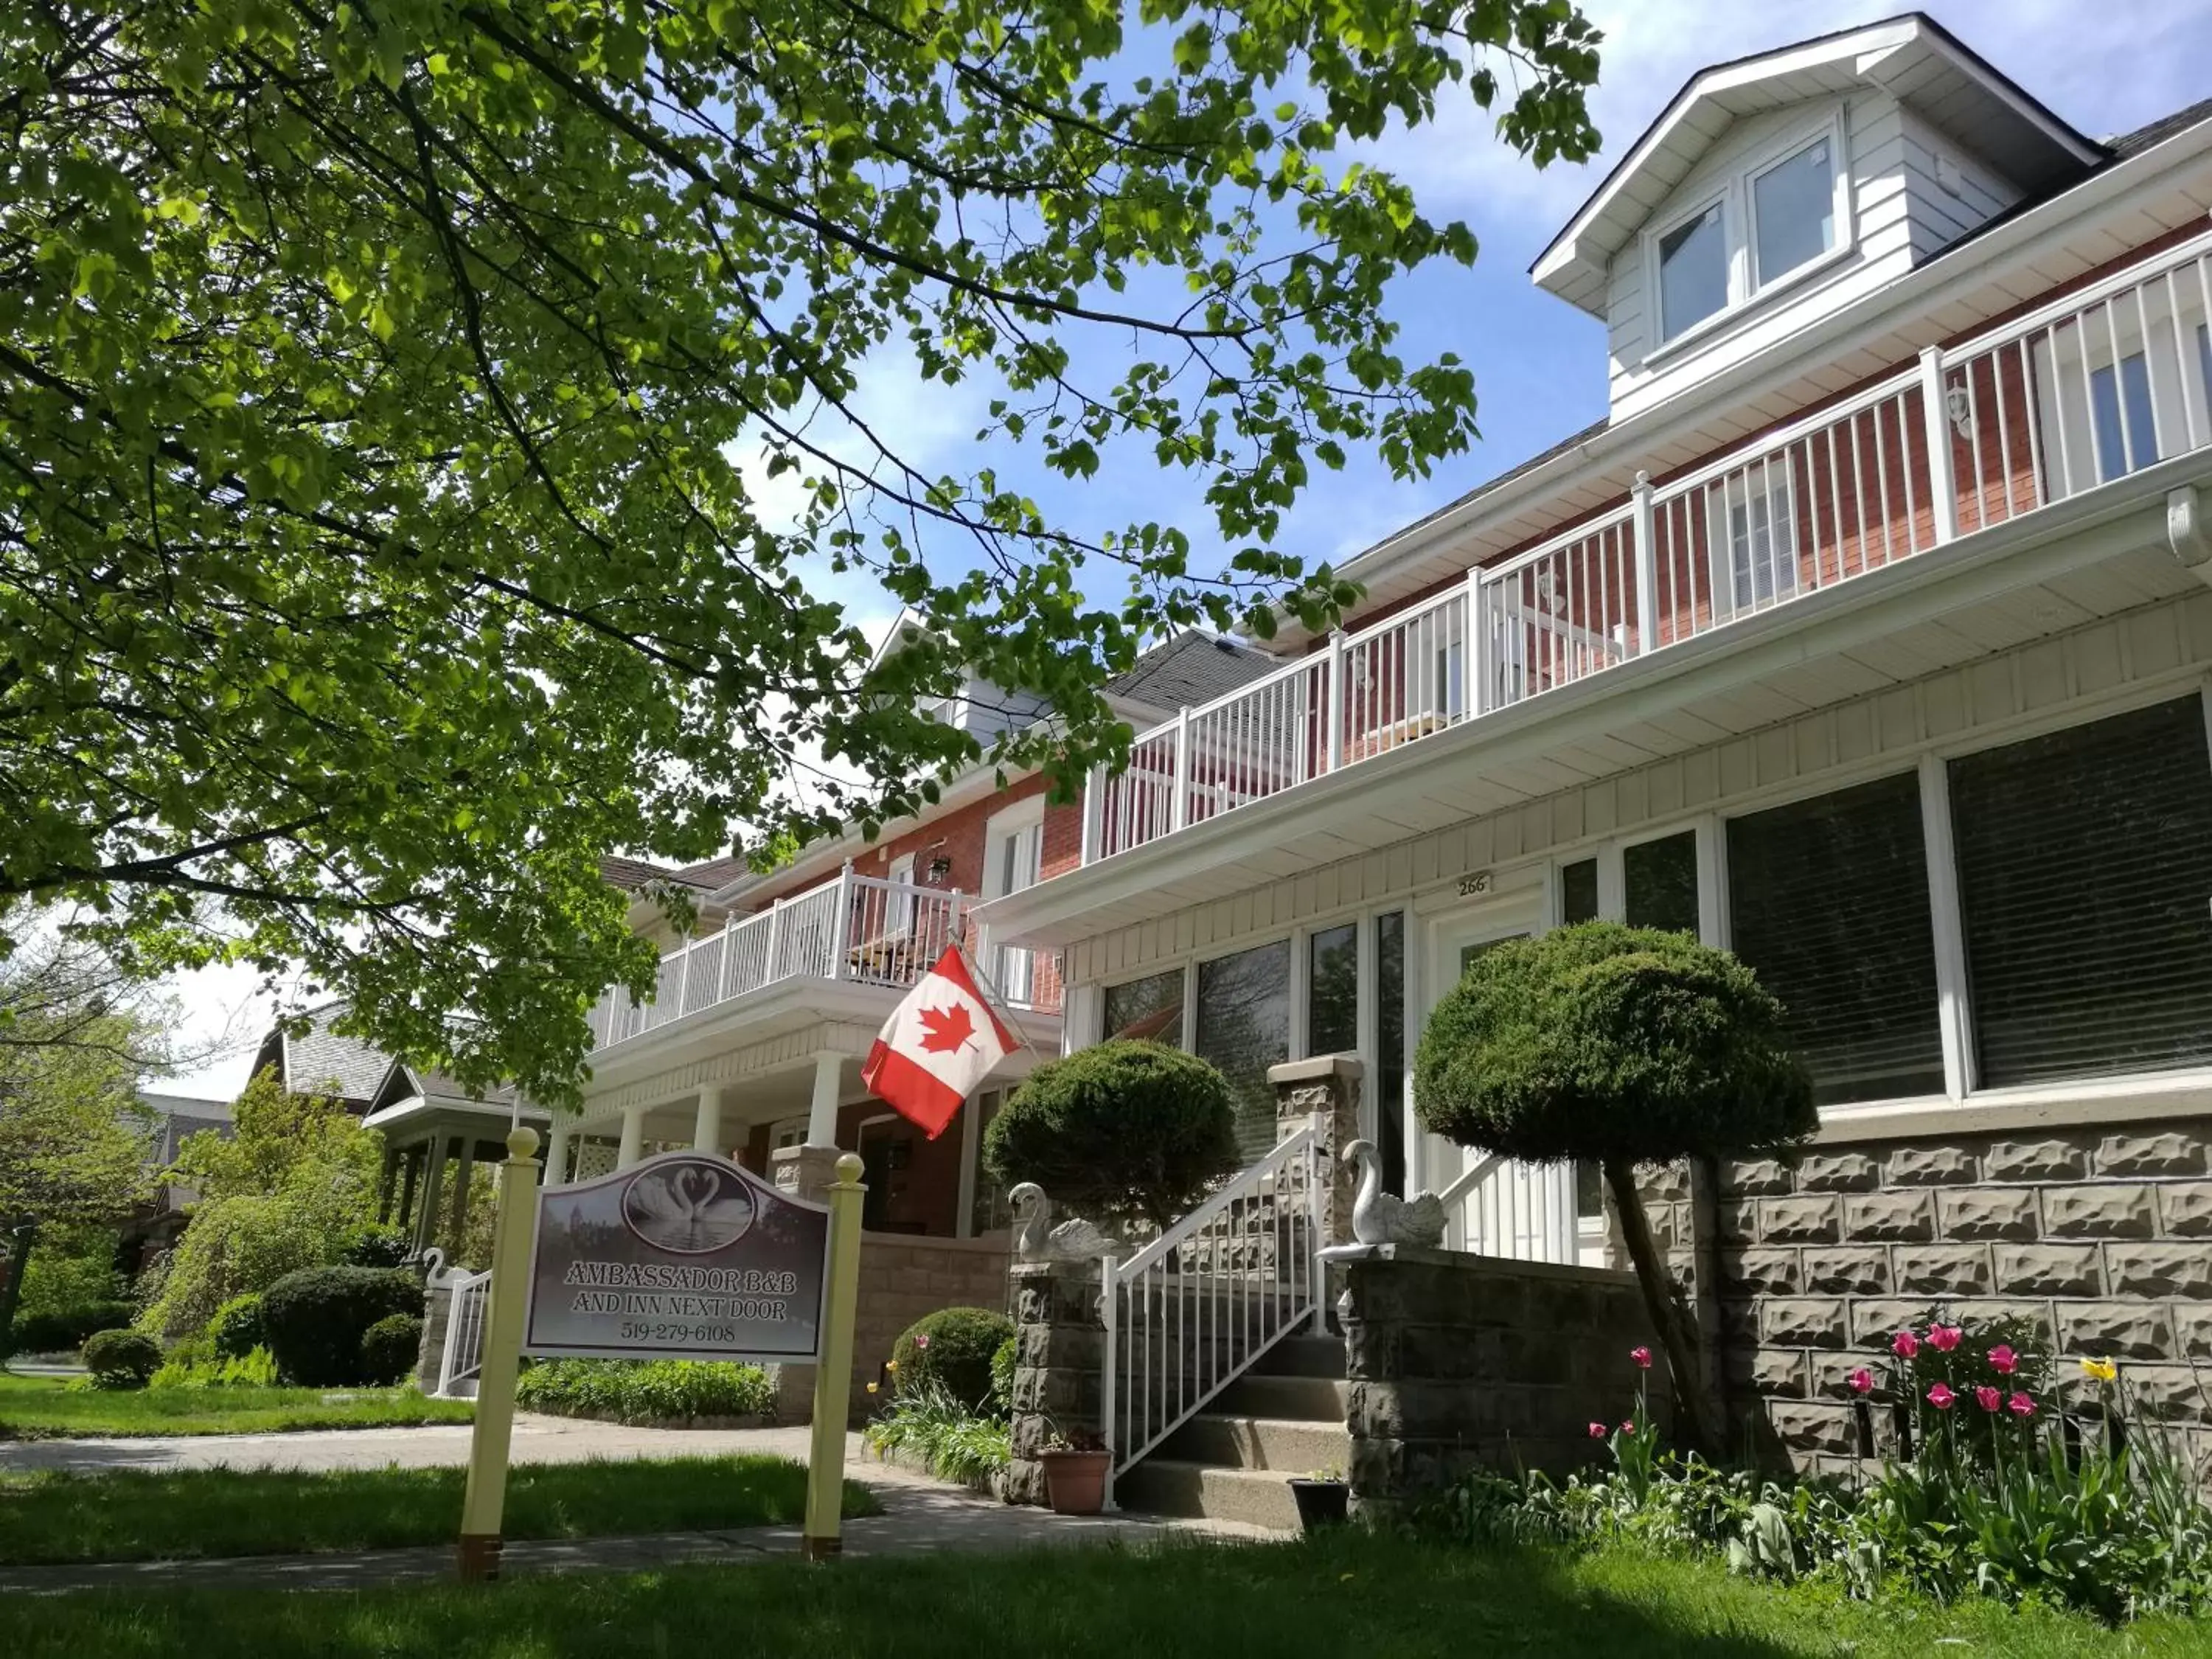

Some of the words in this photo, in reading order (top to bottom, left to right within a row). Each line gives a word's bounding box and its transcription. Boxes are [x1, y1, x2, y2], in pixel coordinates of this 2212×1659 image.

[1460, 874, 1485, 897] 266
[564, 1261, 740, 1294] AMBASSADOR
[744, 1270, 797, 1295] B&B
[571, 1290, 622, 1315] AND
[625, 1293, 664, 1315] INN
[667, 1295, 726, 1318] NEXT
[728, 1298, 787, 1322] DOOR
[620, 1322, 736, 1343] 519-279-6108
